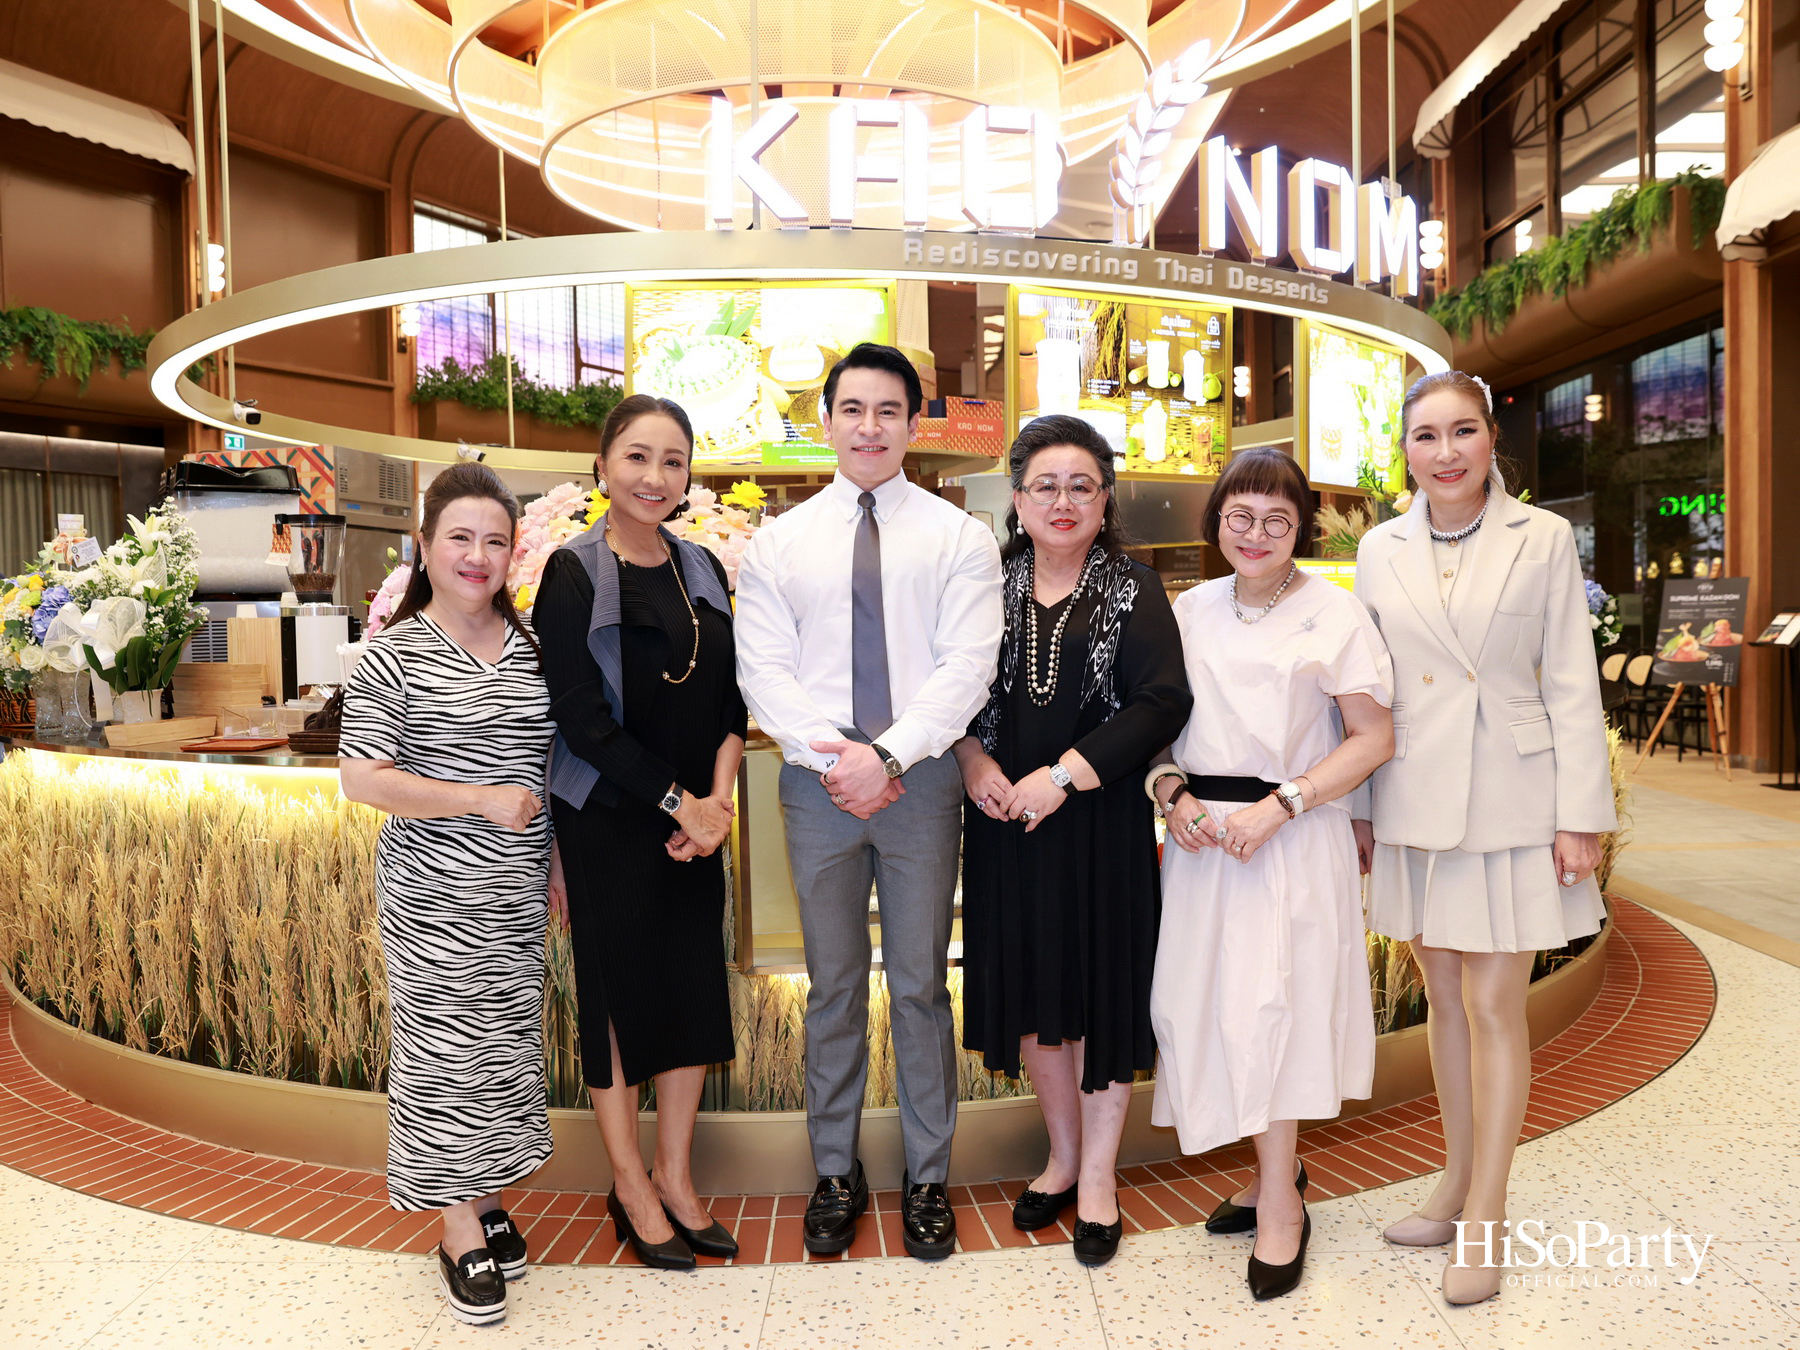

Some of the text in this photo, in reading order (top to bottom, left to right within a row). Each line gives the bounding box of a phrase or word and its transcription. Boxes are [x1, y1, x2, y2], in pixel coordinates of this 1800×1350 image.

[1199, 134, 1418, 298] NOM
[902, 237, 1330, 305] Rediscovering Thai Desserts
[957, 422, 994, 432] KAO NOM
